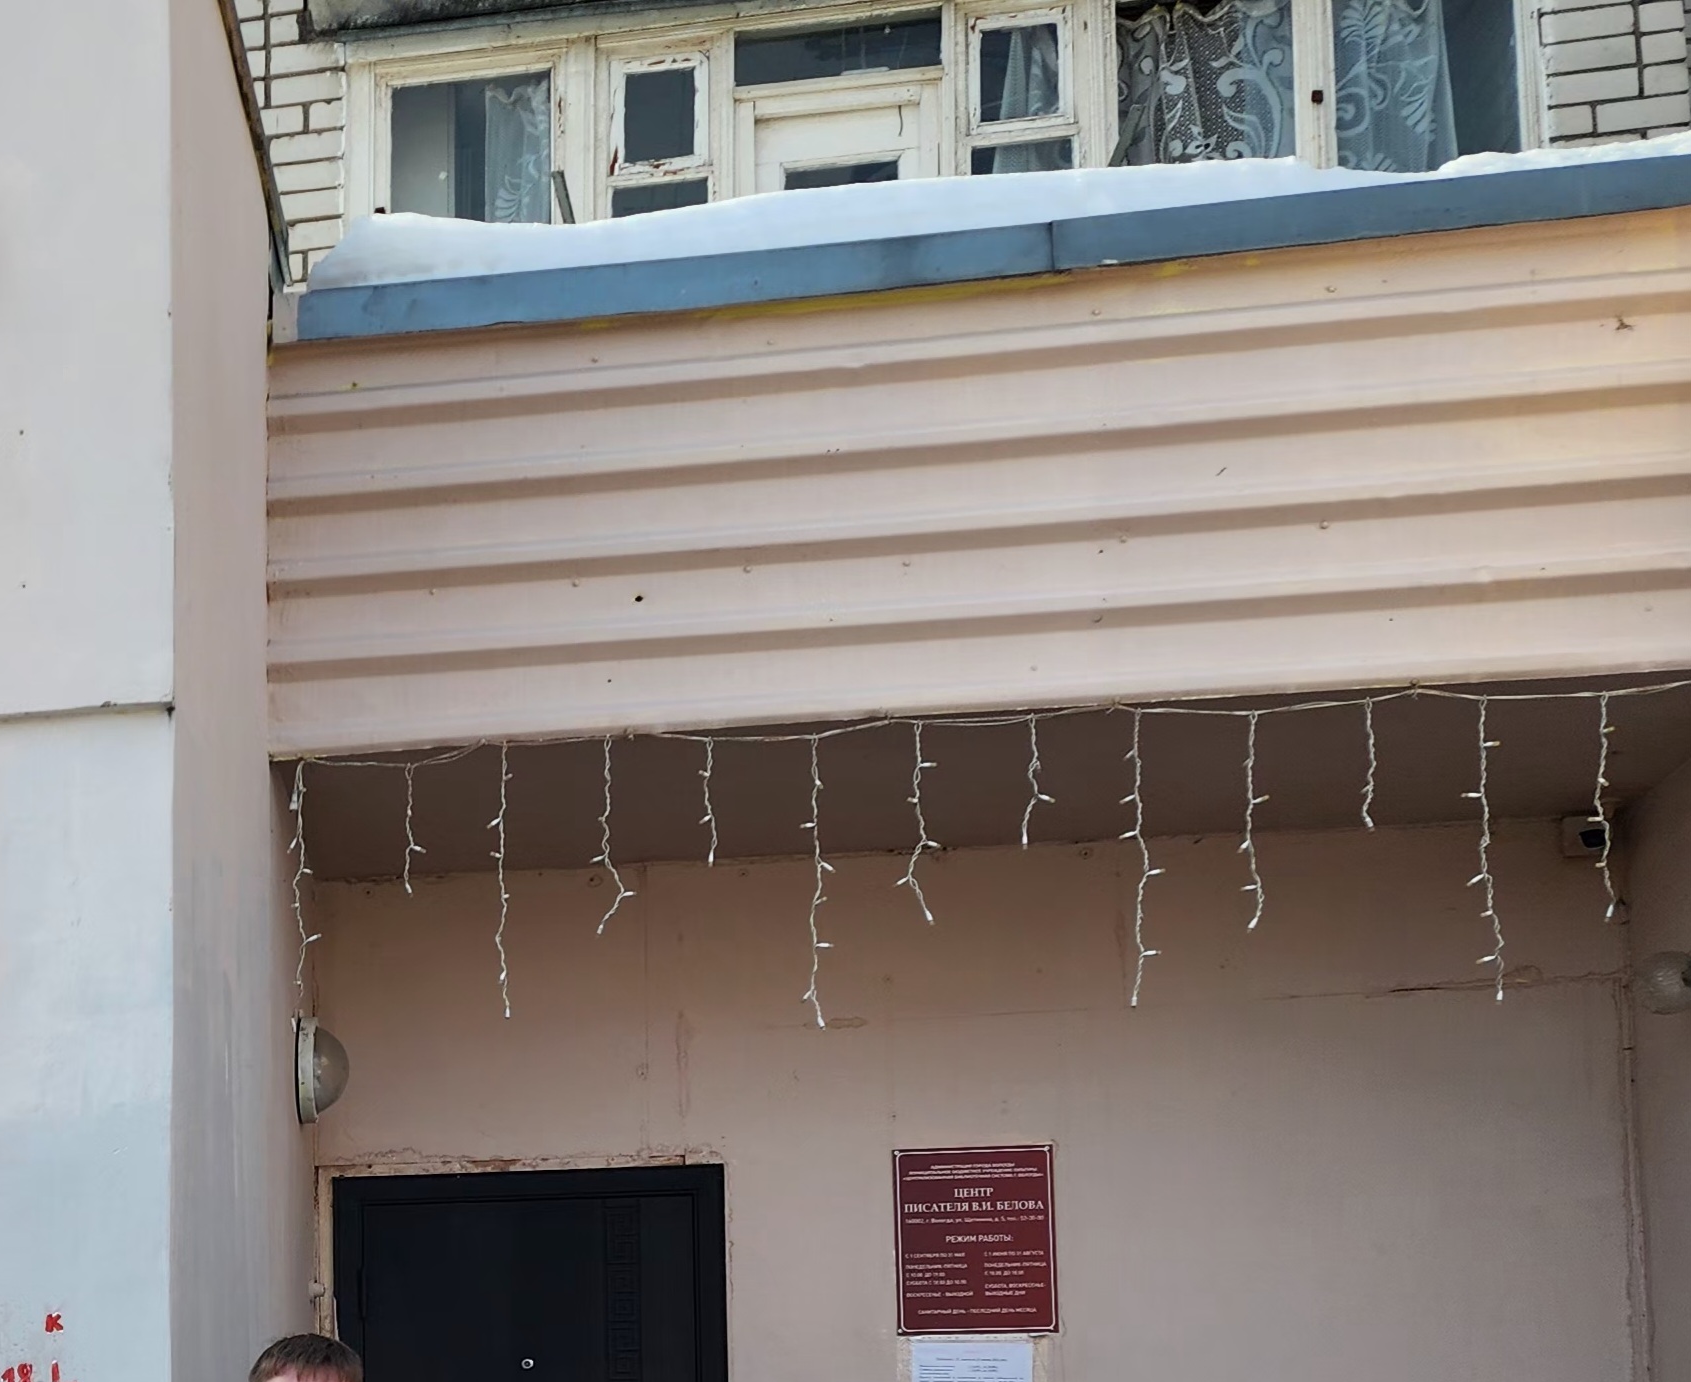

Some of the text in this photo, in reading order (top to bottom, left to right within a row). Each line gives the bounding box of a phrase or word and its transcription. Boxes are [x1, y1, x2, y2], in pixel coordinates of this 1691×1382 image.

[954, 1187, 994, 1199] ЦЕНТР
[904, 1200, 1044, 1213] ПИСАТЕЛЯ В.И. БЕЛОВА
[945, 1234, 1014, 1243] РЕЖИМ РАБОТЫ:
